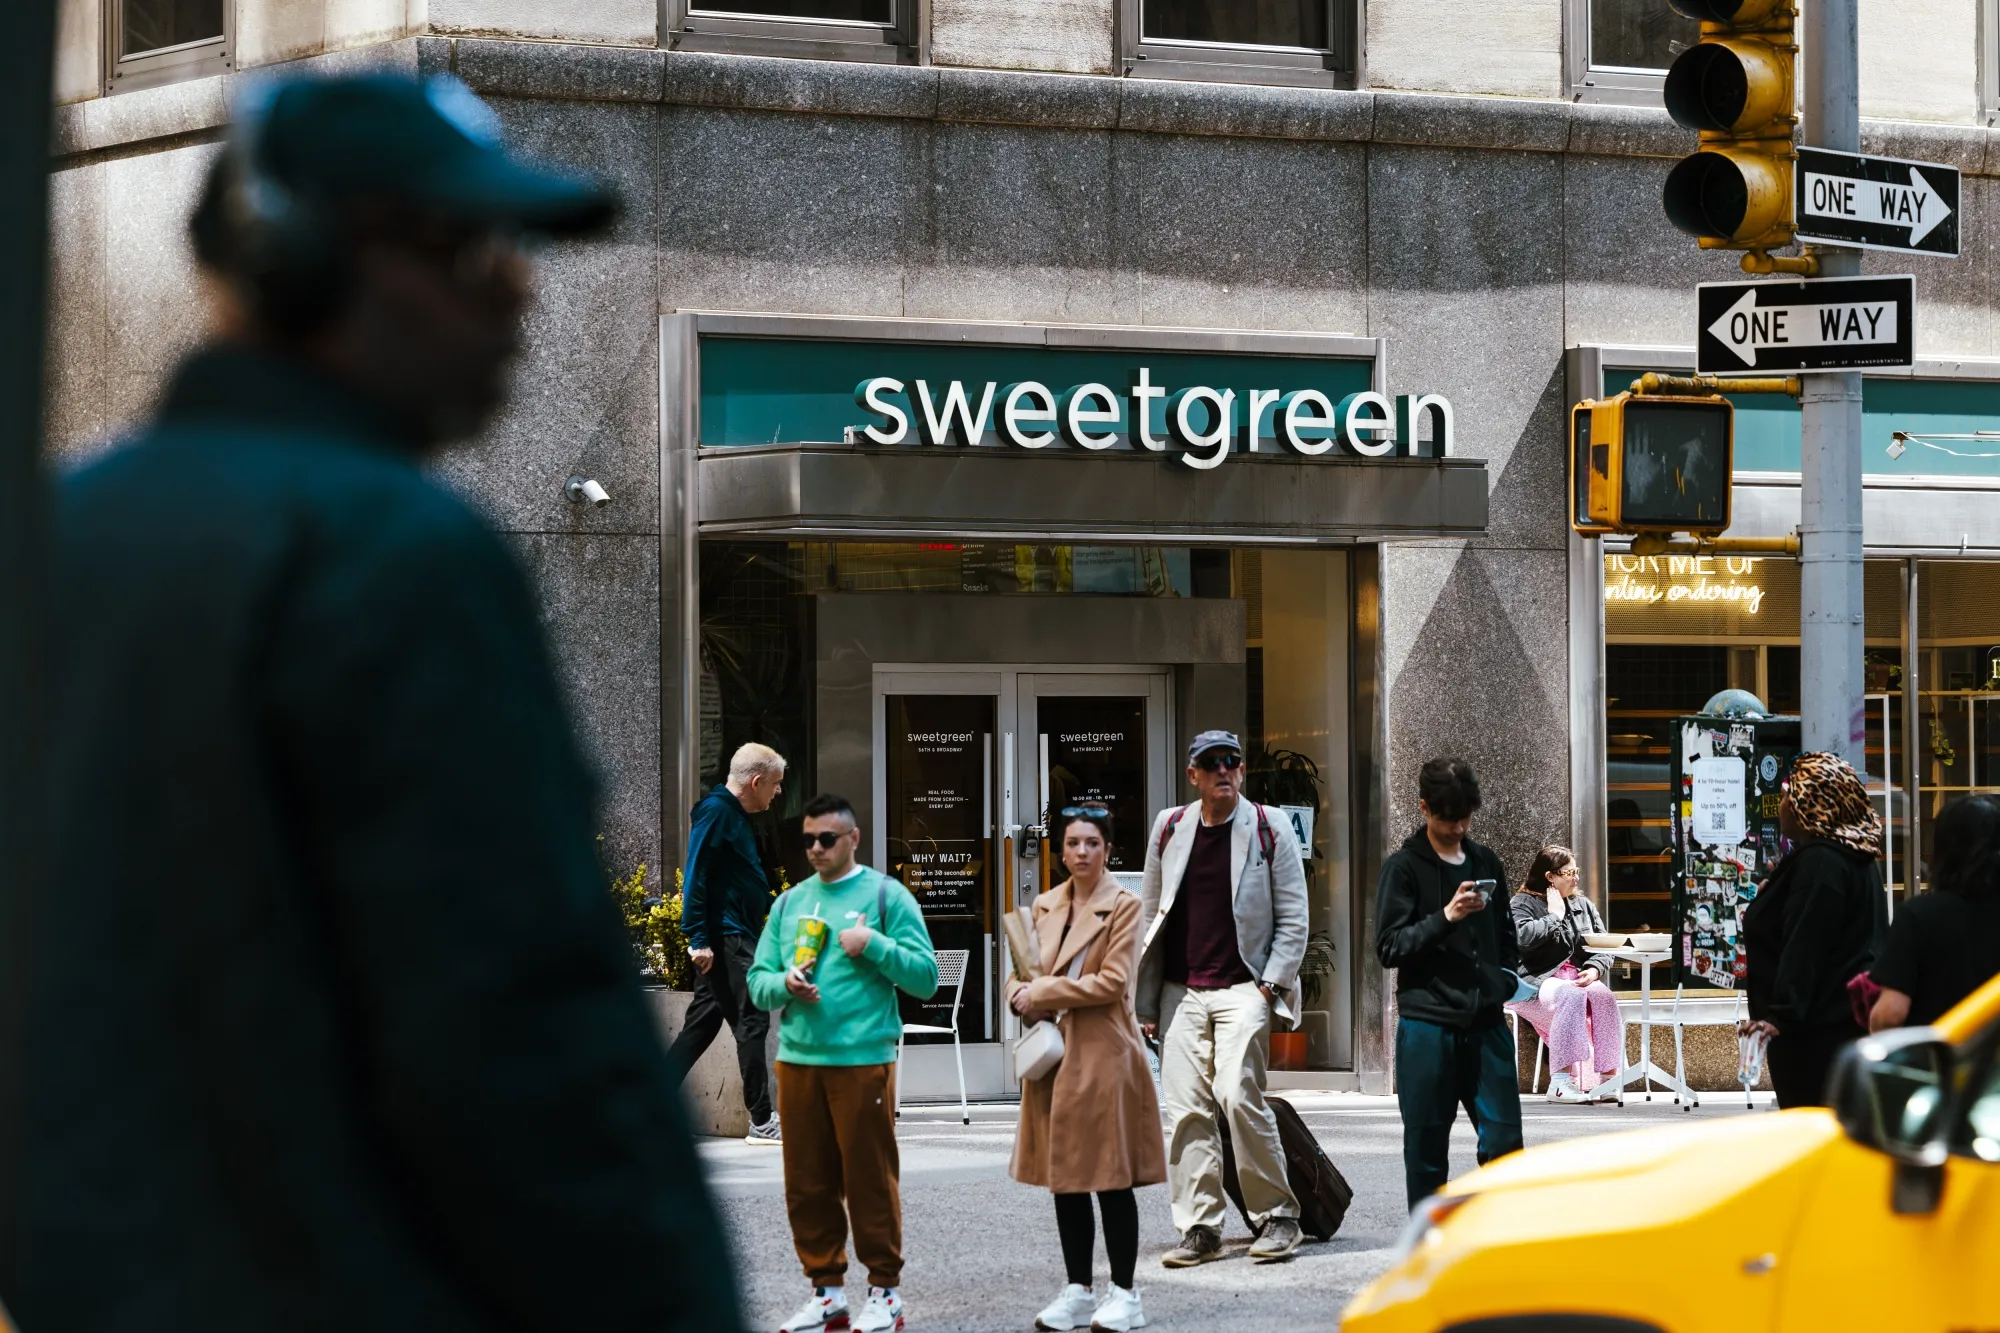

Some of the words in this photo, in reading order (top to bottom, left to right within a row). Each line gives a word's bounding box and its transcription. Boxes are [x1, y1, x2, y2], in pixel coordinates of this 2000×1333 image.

[1813, 178, 1856, 215] ONE
[1879, 187, 1927, 224] WAY
[1730, 310, 1789, 345] ONE
[1819, 307, 1884, 342] WAY
[855, 367, 1454, 470] sweetgreen
[1611, 554, 1660, 574] ICK
[1670, 556, 1716, 575] ME
[1604, 575, 1663, 604] nline
[1667, 577, 1765, 614] ordering
[1060, 731, 1124, 743] sweetgreen
[1291, 812, 1307, 844] A
[911, 853, 935, 863] WHY
[939, 853, 972, 863] WAIT?
